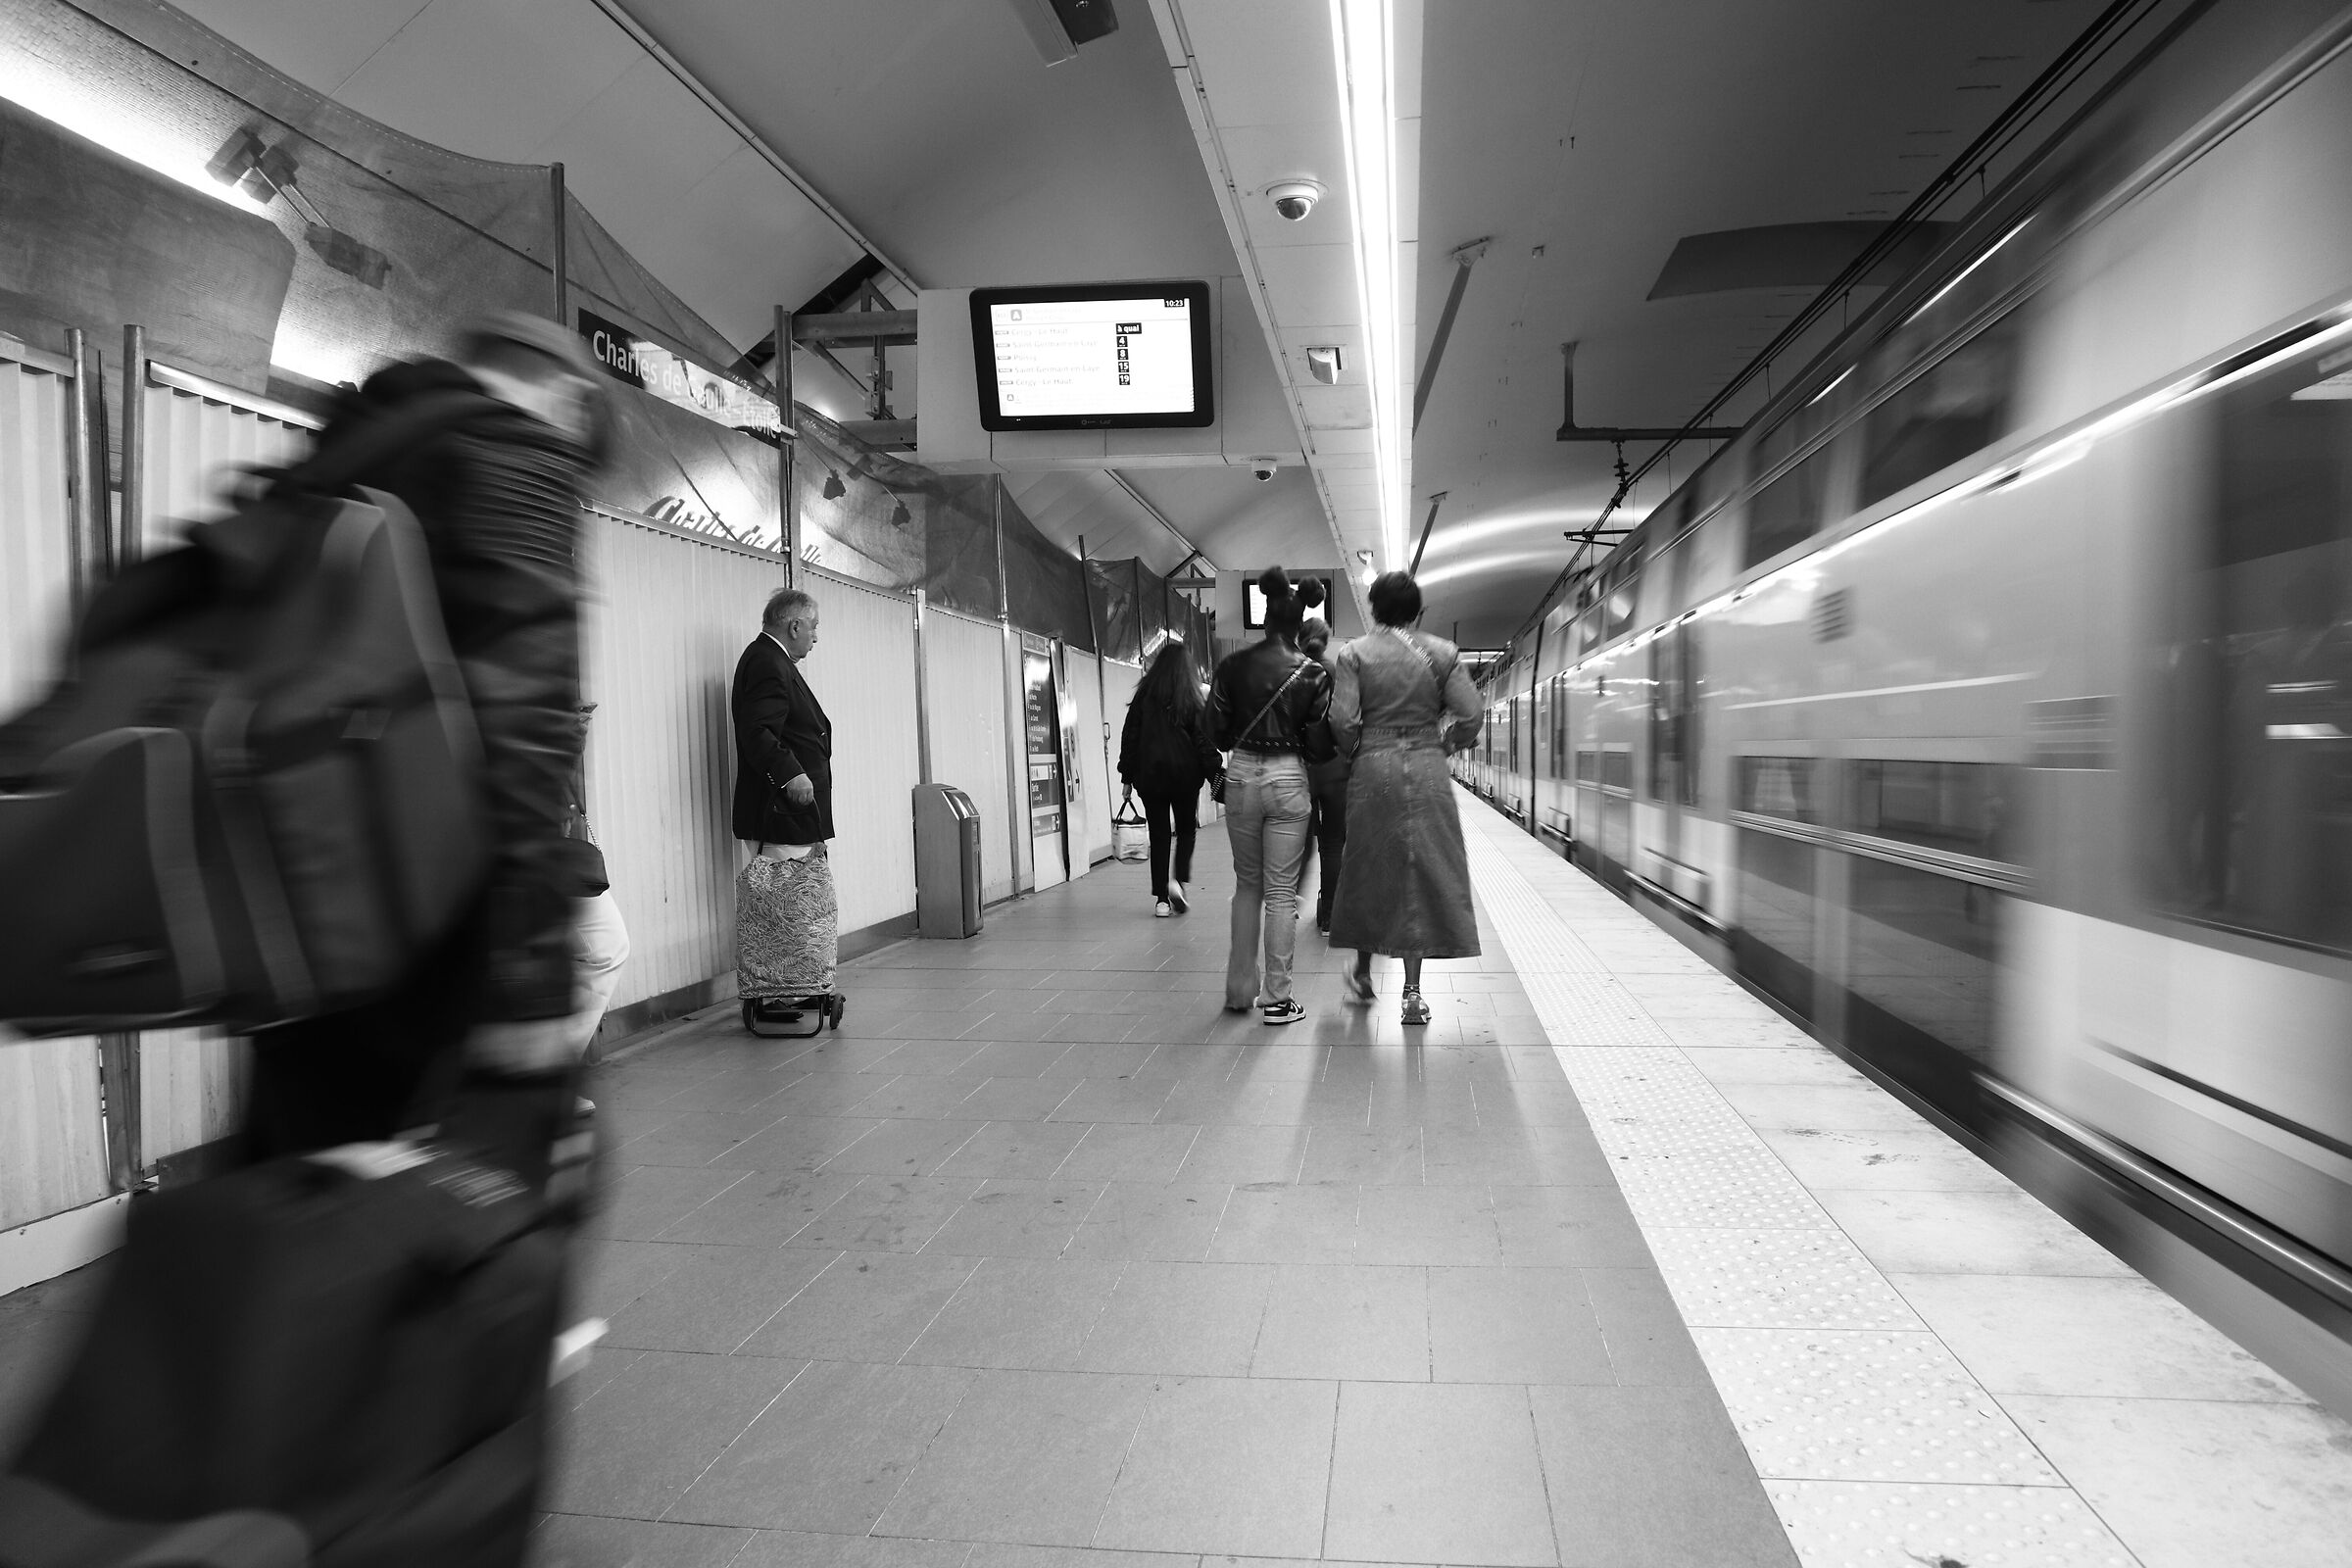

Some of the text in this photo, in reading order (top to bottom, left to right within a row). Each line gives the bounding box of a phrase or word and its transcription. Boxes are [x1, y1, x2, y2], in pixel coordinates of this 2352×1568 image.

[1119, 349, 1126, 358] 8
[593, 330, 657, 384] Charles
[662, 368, 682, 395] de
[1119, 374, 1130, 383] 19
